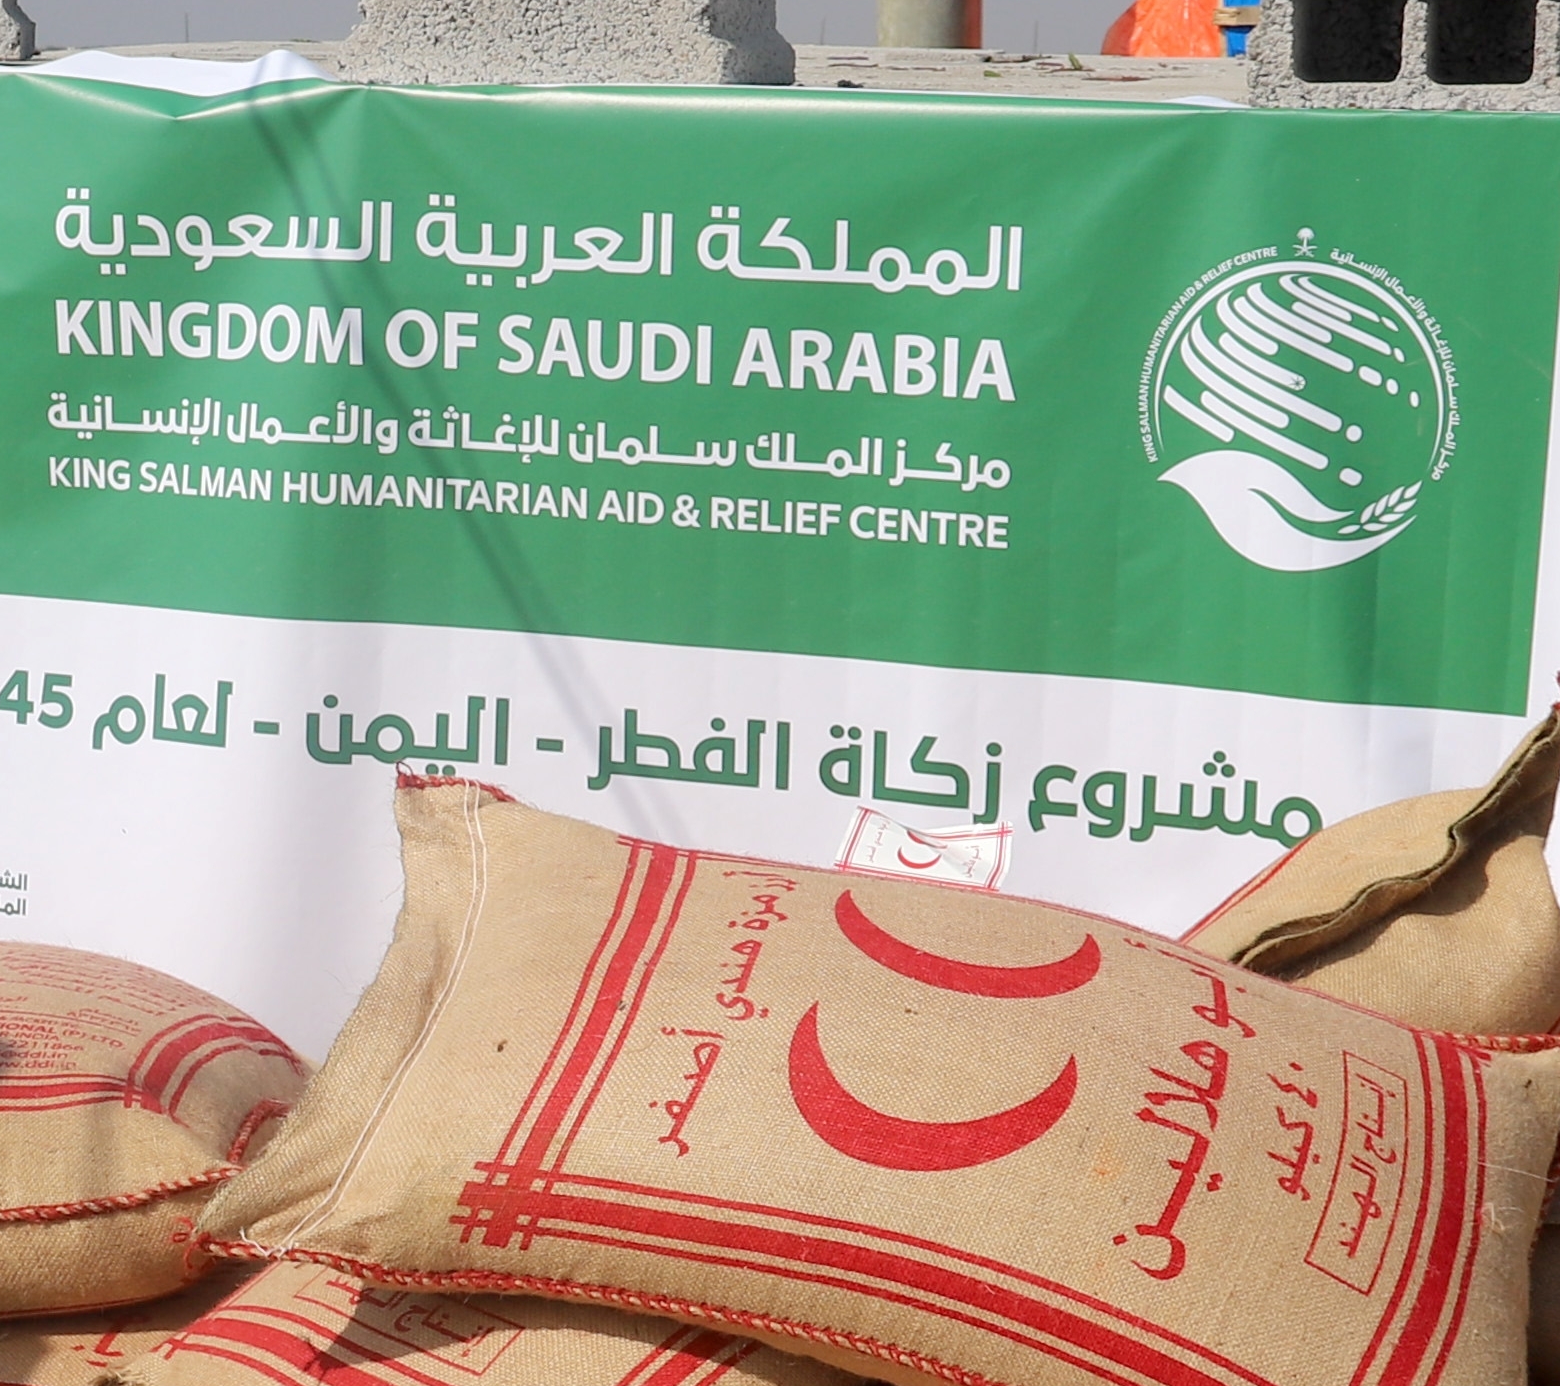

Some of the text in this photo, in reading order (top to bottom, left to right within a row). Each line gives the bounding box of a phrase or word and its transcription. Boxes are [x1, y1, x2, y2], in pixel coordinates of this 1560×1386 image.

[53, 186, 1024, 297] المملكة العربية السعودية
[54, 298, 1017, 402] KINGDOM OF SAUDI ARABIA
[1138, 245, 1279, 464] KING SALMAN HUMANITARIAN AID & RELIEF CENTRE
[46, 390, 1013, 493] مركز الملك سلمان للإغاثة والأعمال الإنسانية
[48, 455, 1011, 551] KING SALMAN HUMANITARIAN AID & RELIEF CENTRE
[91, 673, 235, 751] لعام
[252, 720, 281, 736] -
[305, 693, 511, 778] اليمن
[535, 737, 565, 753] -
[586, 706, 792, 792] الفطر
[816, 721, 1006, 826] زكاة
[1027, 749, 1326, 852] مشروع
[728, 894, 788, 931] مزة
[716, 939, 770, 1021] هندي
[649, 1027, 724, 1157] أصفر
[1112, 939, 1257, 1281] أبو هلالين
[1267, 1106, 1321, 1201] كيلو
